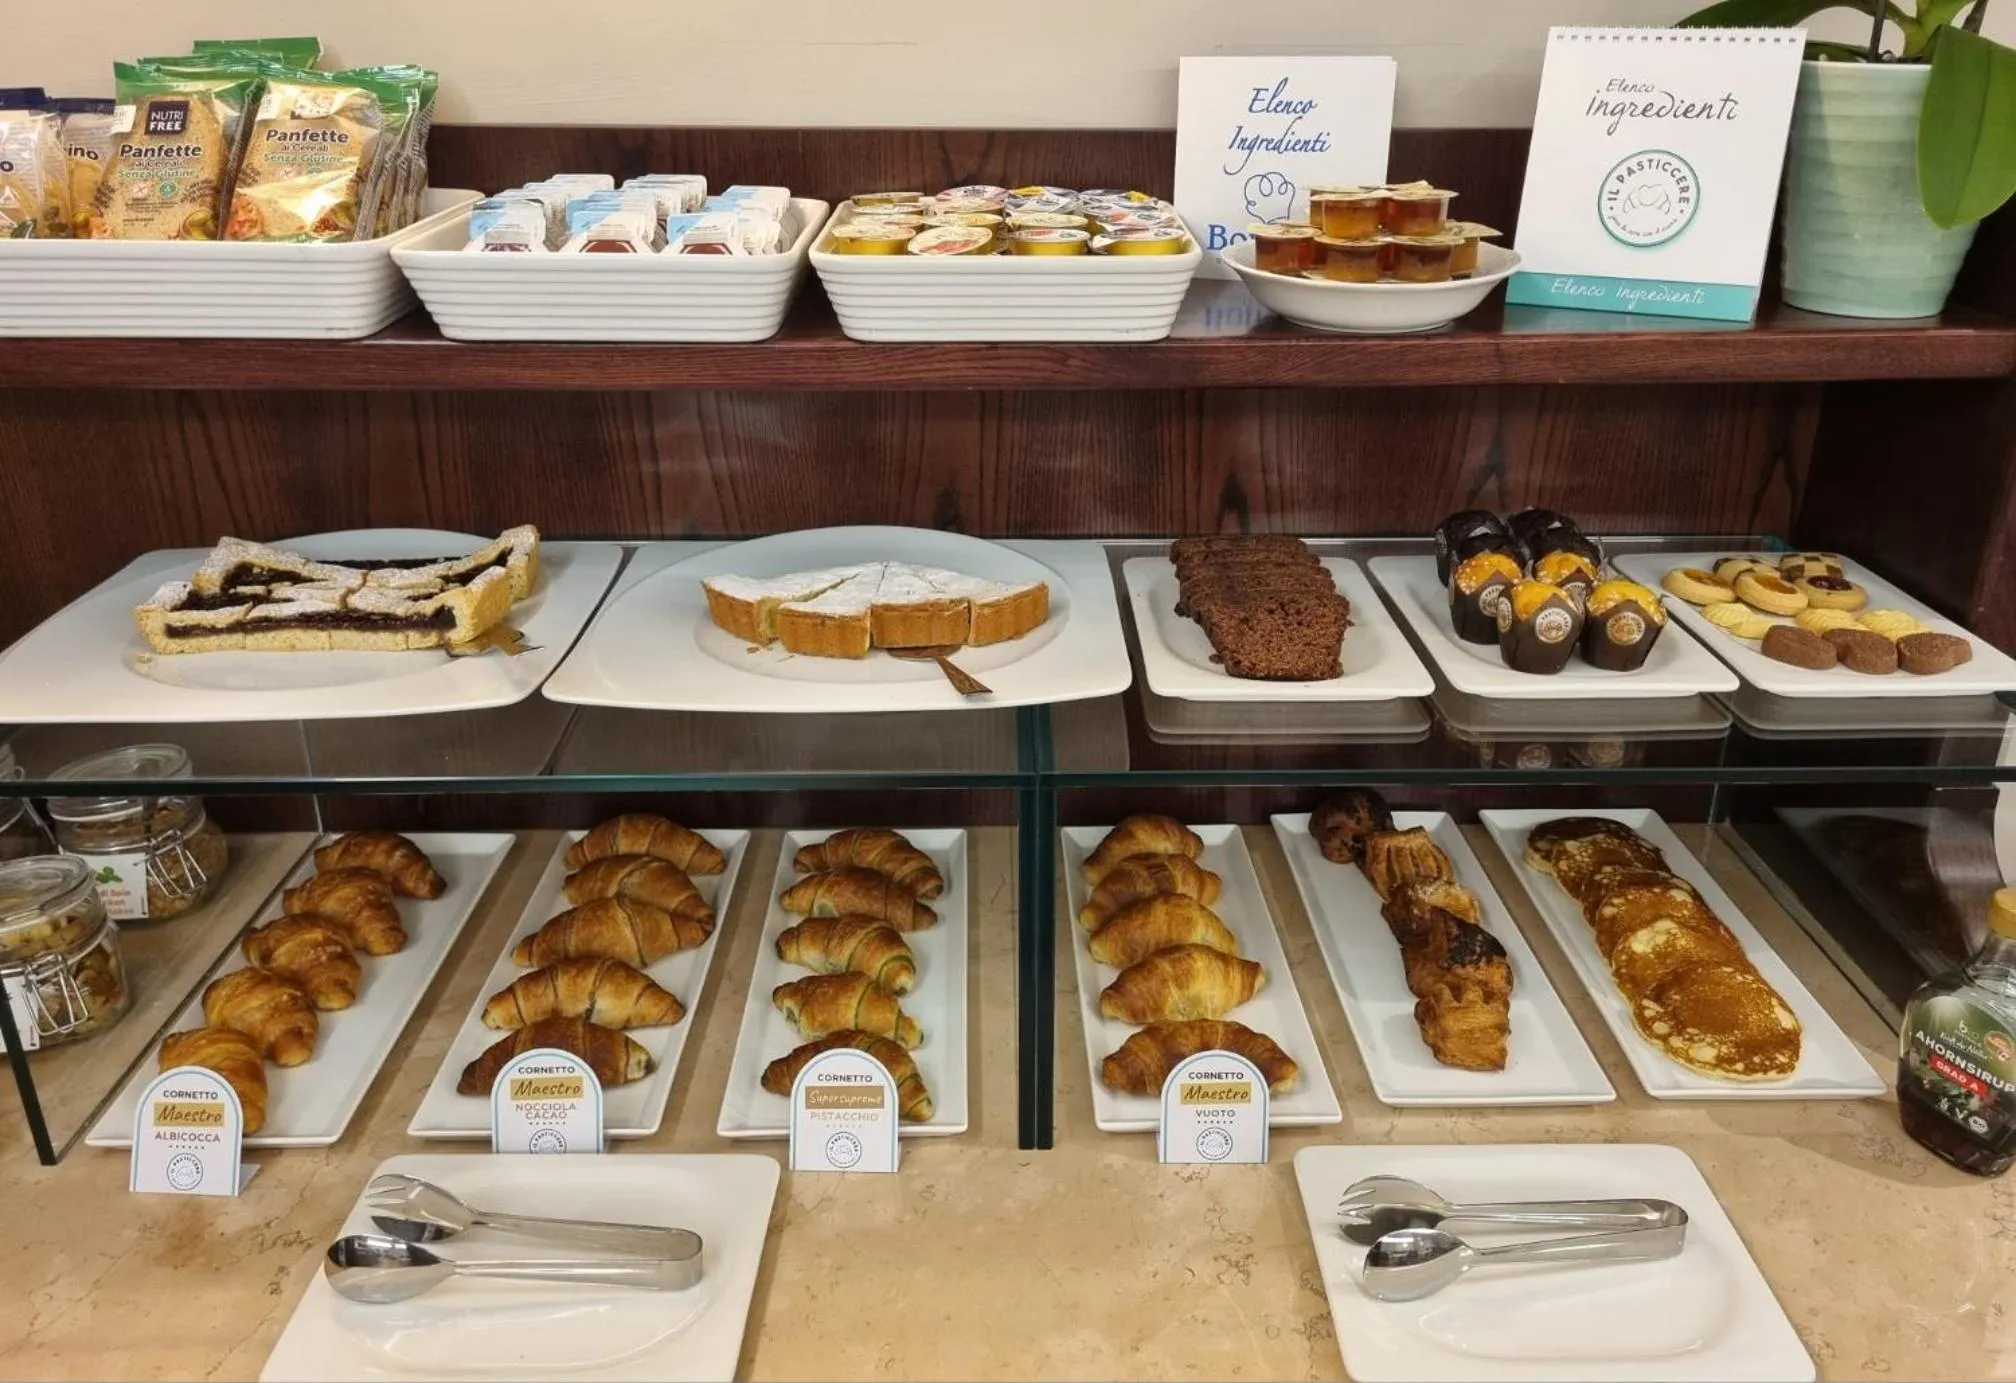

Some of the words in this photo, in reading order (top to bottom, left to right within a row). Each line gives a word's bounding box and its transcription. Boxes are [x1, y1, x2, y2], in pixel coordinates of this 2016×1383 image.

[1606, 78, 1656, 94] Elenco
[1248, 77, 1317, 115] Elenco
[151, 110, 184, 121] NUTRI
[1586, 89, 1739, 136] ingredienti
[149, 121, 183, 131] FREE
[265, 128, 349, 143] Panfette
[64, 143, 99, 160] ino
[120, 144, 202, 157] Panfette
[1223, 115, 1331, 175] Ingredienti
[263, 152, 297, 163] Senza
[119, 169, 152, 178] Senza
[1607, 187, 1621, 202] IL
[1615, 158, 1690, 205] PASTICCERE
[1550, 277, 1605, 298] Elenco
[1615, 281, 1706, 310] ingredienti
[1915, 1029, 2016, 1093] AHORNSIRUP
[518, 1066, 576, 1074] CORNETTO
[1188, 1072, 1244, 1080] CORNETTO
[1935, 1059, 1968, 1085] GRAD
[1970, 1081, 1980, 1091] A
[817, 1074, 873, 1083] CORNETTO
[163, 1090, 219, 1100] CORNETTO
[515, 1080, 581, 1097] Maestro
[1184, 1085, 1249, 1101] Maestro
[807, 1089, 883, 1107] Supersupreme
[157, 1104, 223, 1122] Maestro
[515, 1102, 577, 1112] NOCCIOLA
[1195, 1109, 1236, 1117] VUOTO
[525, 1111, 568, 1120] CACAO
[810, 1111, 879, 1121] PISTACCHIO
[154, 1131, 222, 1143] ALBICOCCA
